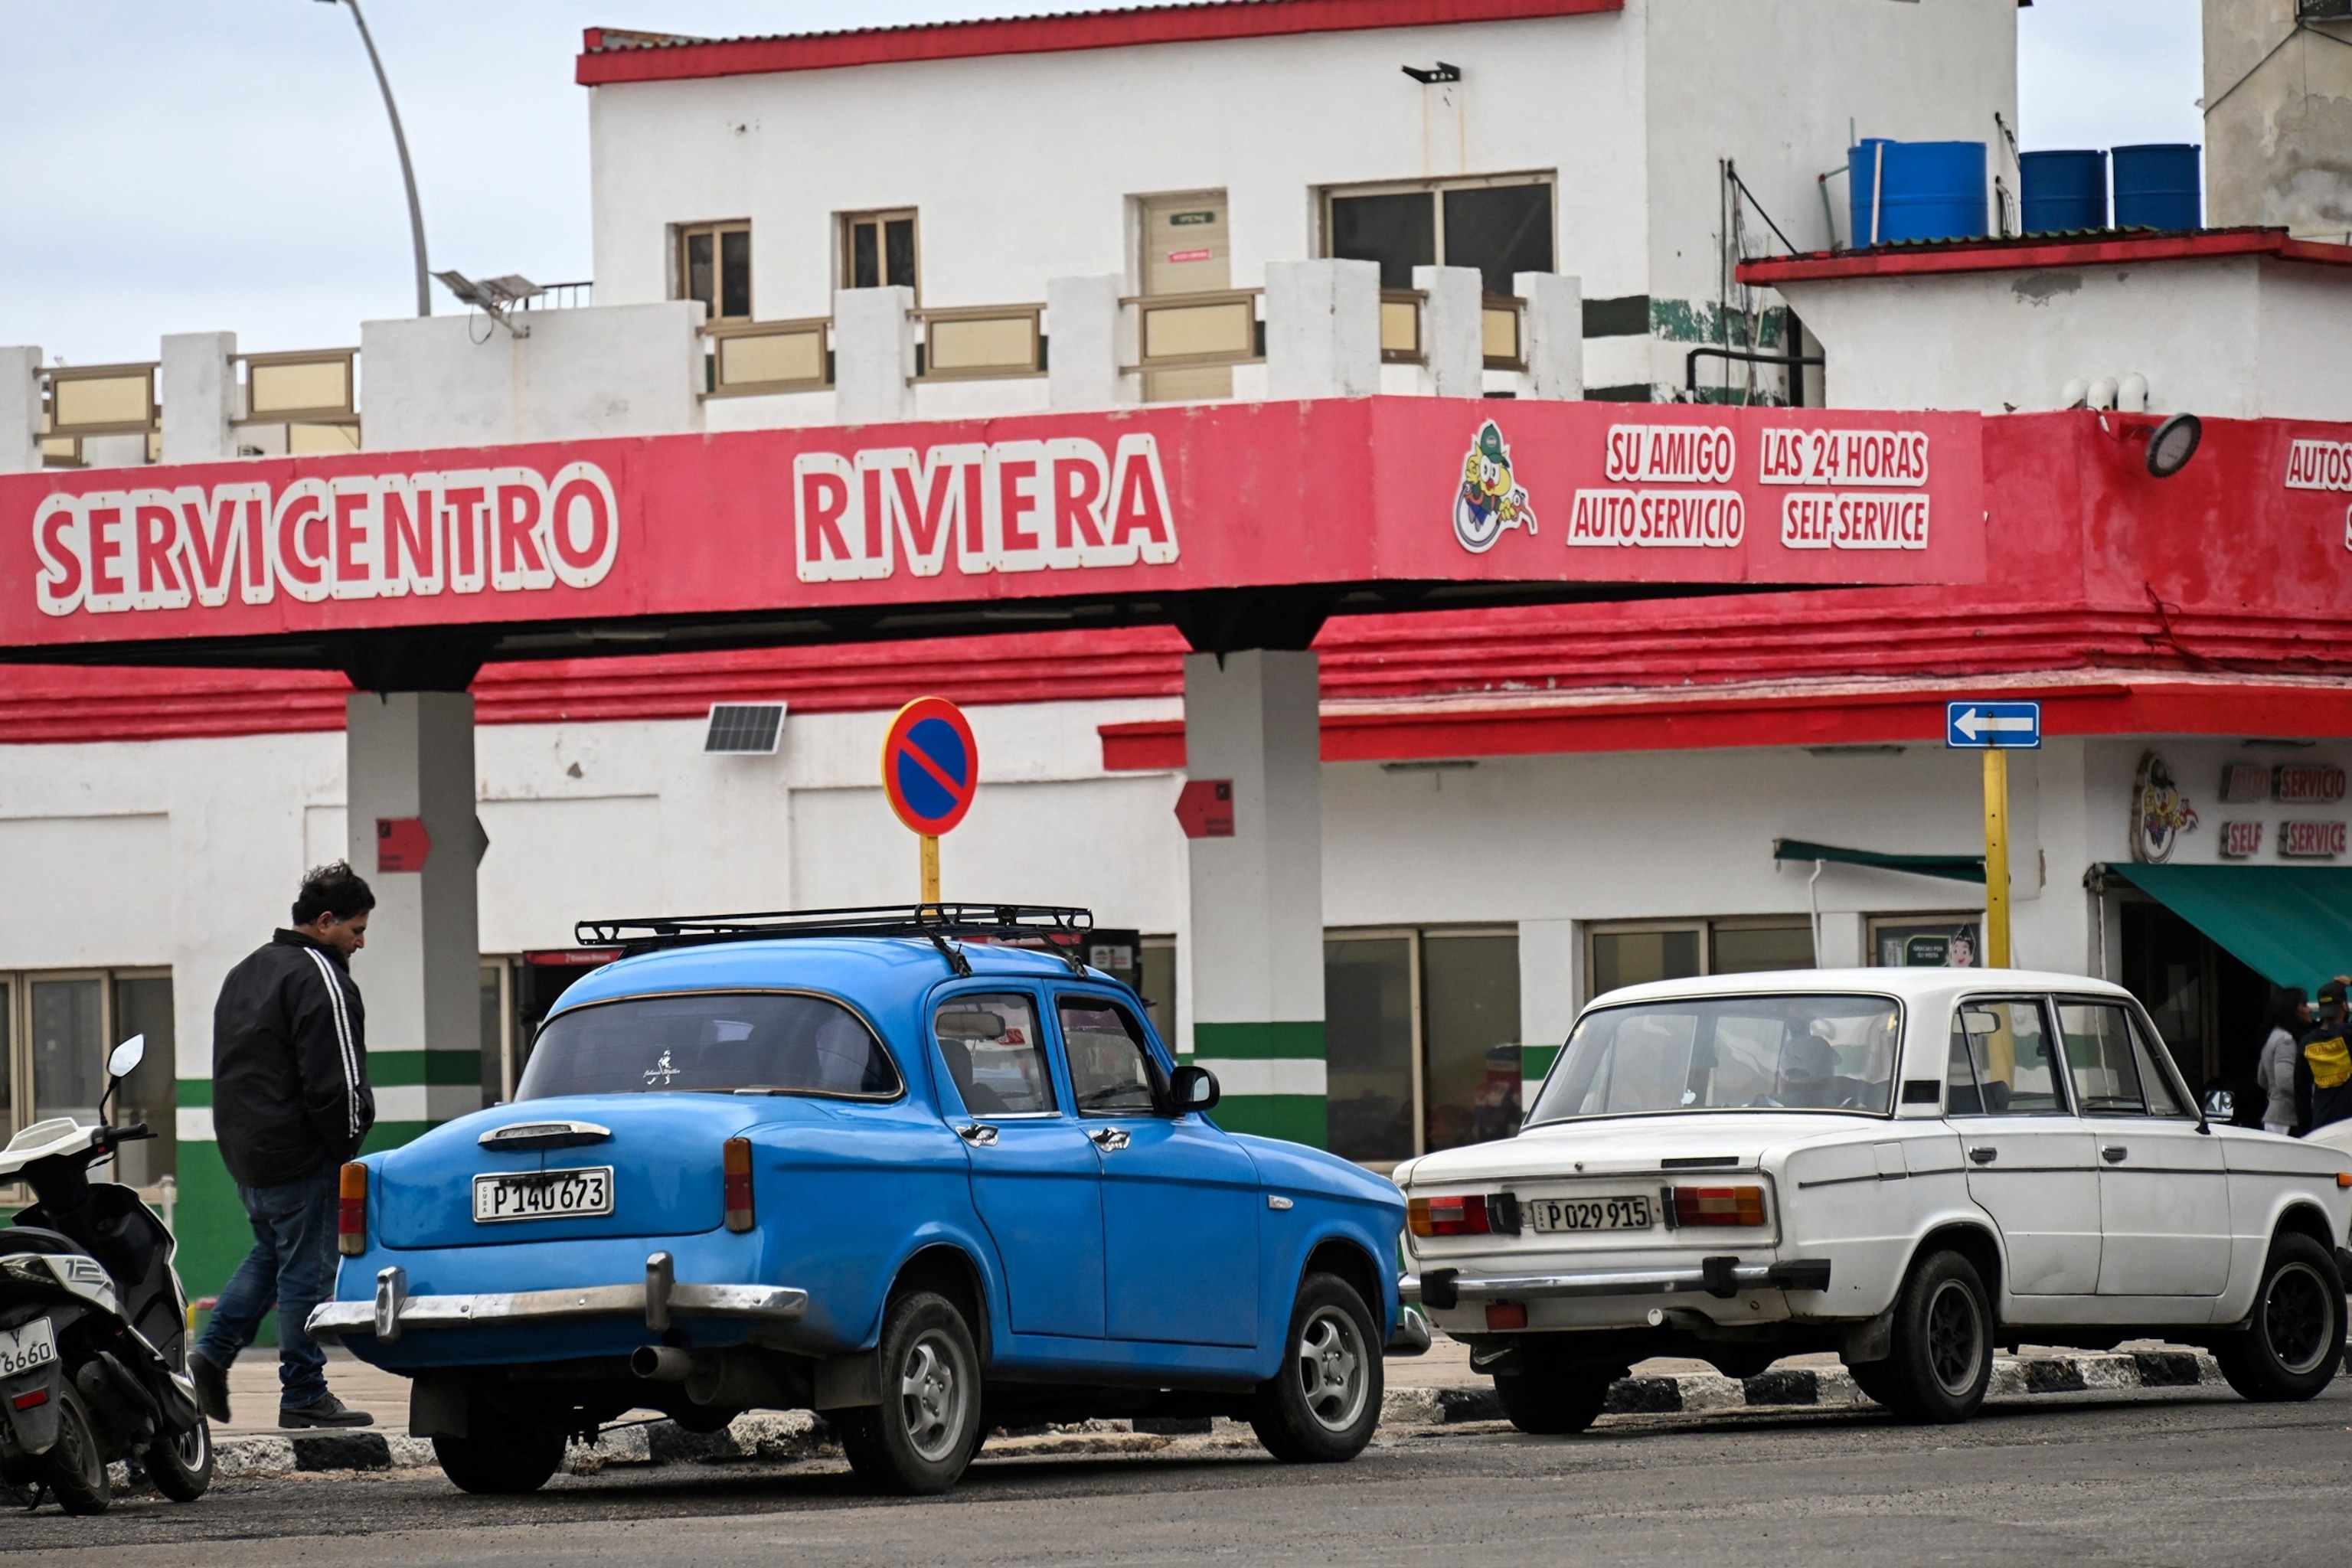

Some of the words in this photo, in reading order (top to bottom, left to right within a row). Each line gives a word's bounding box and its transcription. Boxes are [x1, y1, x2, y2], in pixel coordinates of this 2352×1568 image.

[1611, 432, 1642, 475] SU
[1648, 433, 1731, 475] AMIGO
[1763, 434, 1803, 476] LAS
[1812, 436, 1839, 477] 24
[1847, 436, 1925, 479] HORAS
[41, 475, 609, 602] SERVICENTRO
[800, 450, 1170, 567] RIVIERA
[1786, 500, 1834, 540] SELF
[1838, 501, 1926, 541] SERVICE
[2281, 768, 2347, 799] SERVICIO
[2230, 823, 2262, 854] SELF
[2288, 823, 2347, 854] SERVICE
